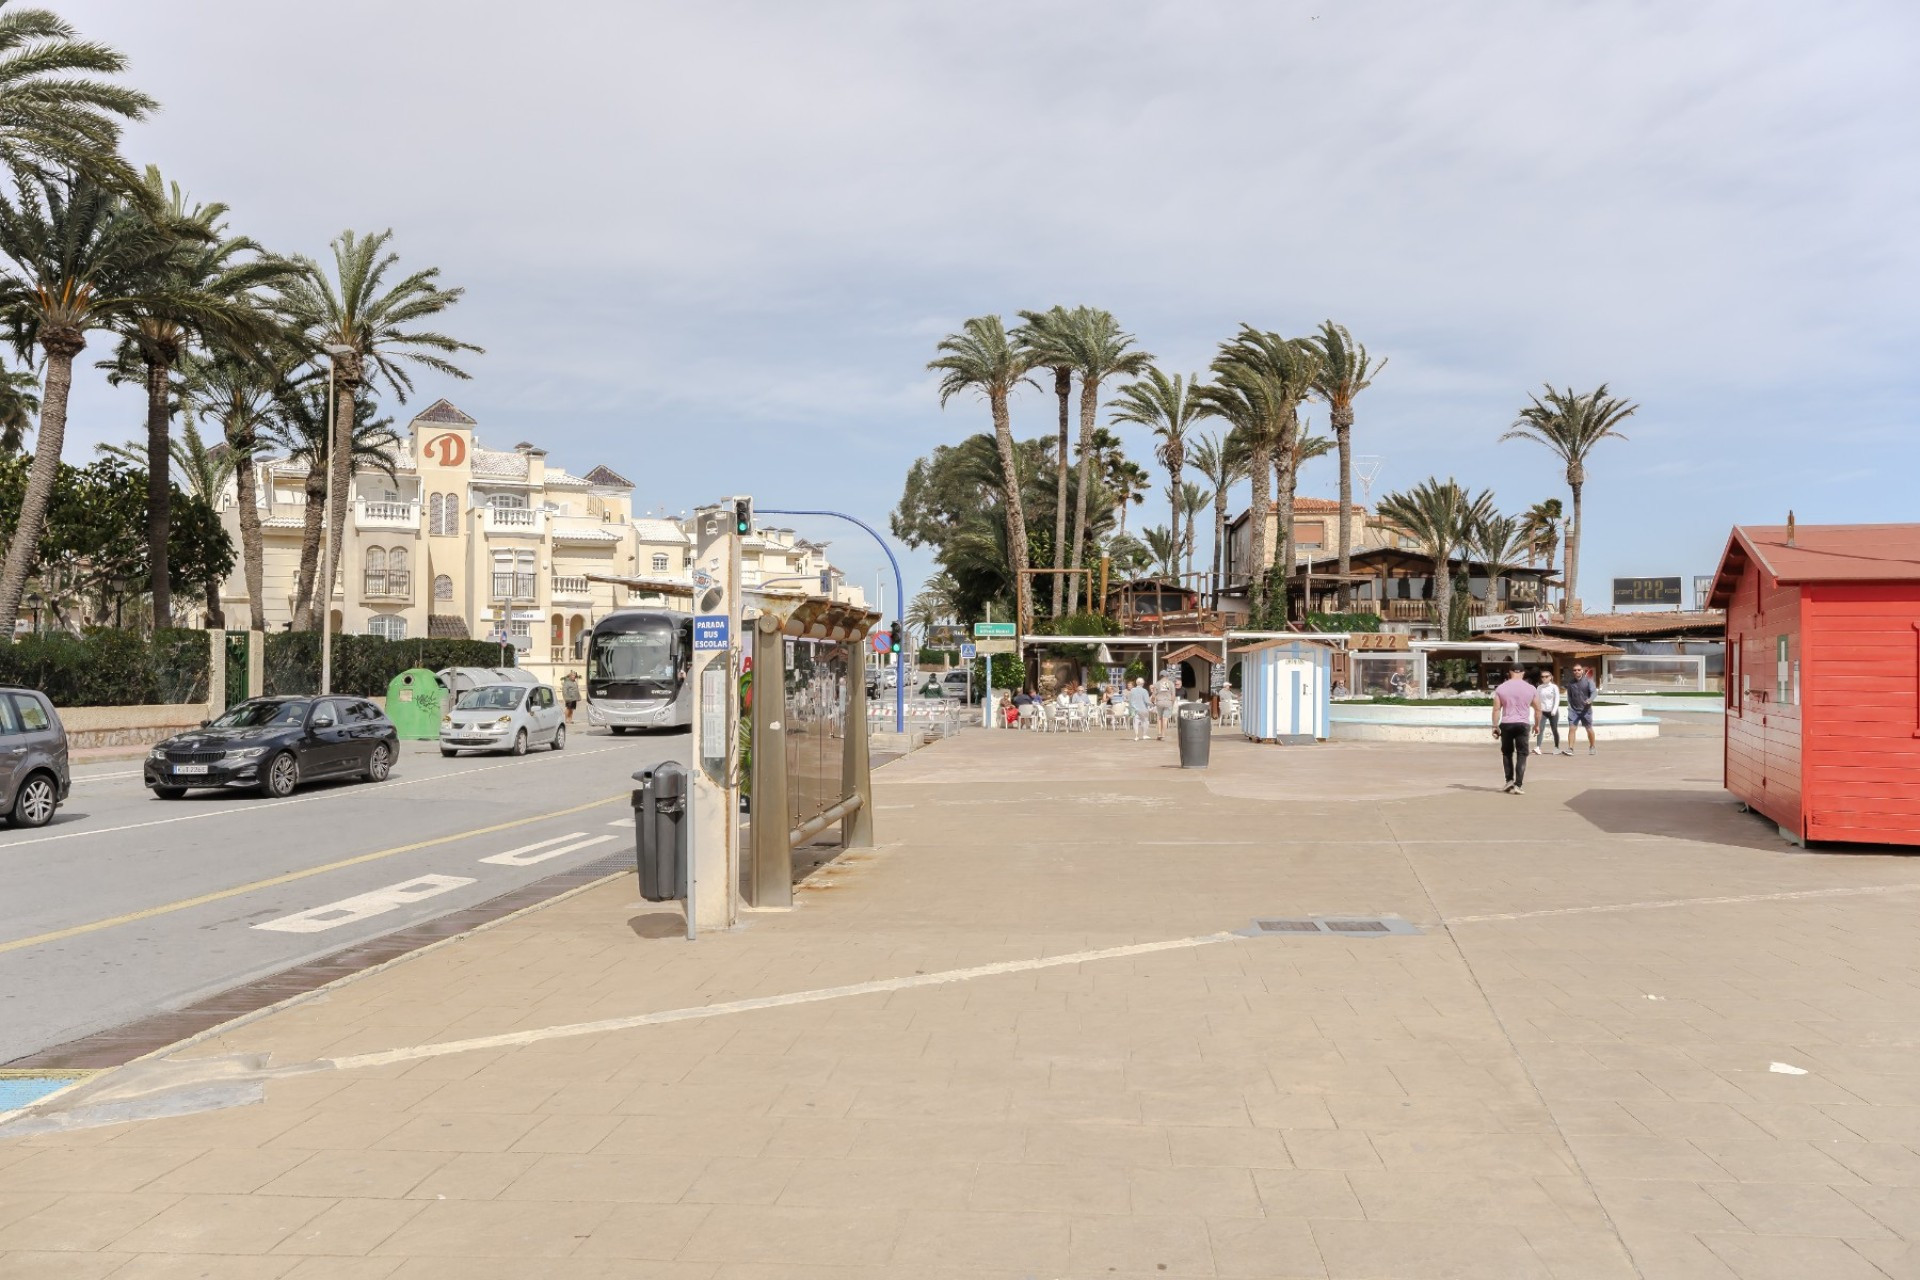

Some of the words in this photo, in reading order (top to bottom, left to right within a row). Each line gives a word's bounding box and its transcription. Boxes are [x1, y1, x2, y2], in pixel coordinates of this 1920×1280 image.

[423, 432, 466, 467] D
[1633, 579, 1664, 599] 222
[697, 621, 725, 629] PARADA
[703, 631, 719, 639] BUS
[695, 640, 728, 649] ESCOLAR
[1361, 635, 1396, 648] 222
